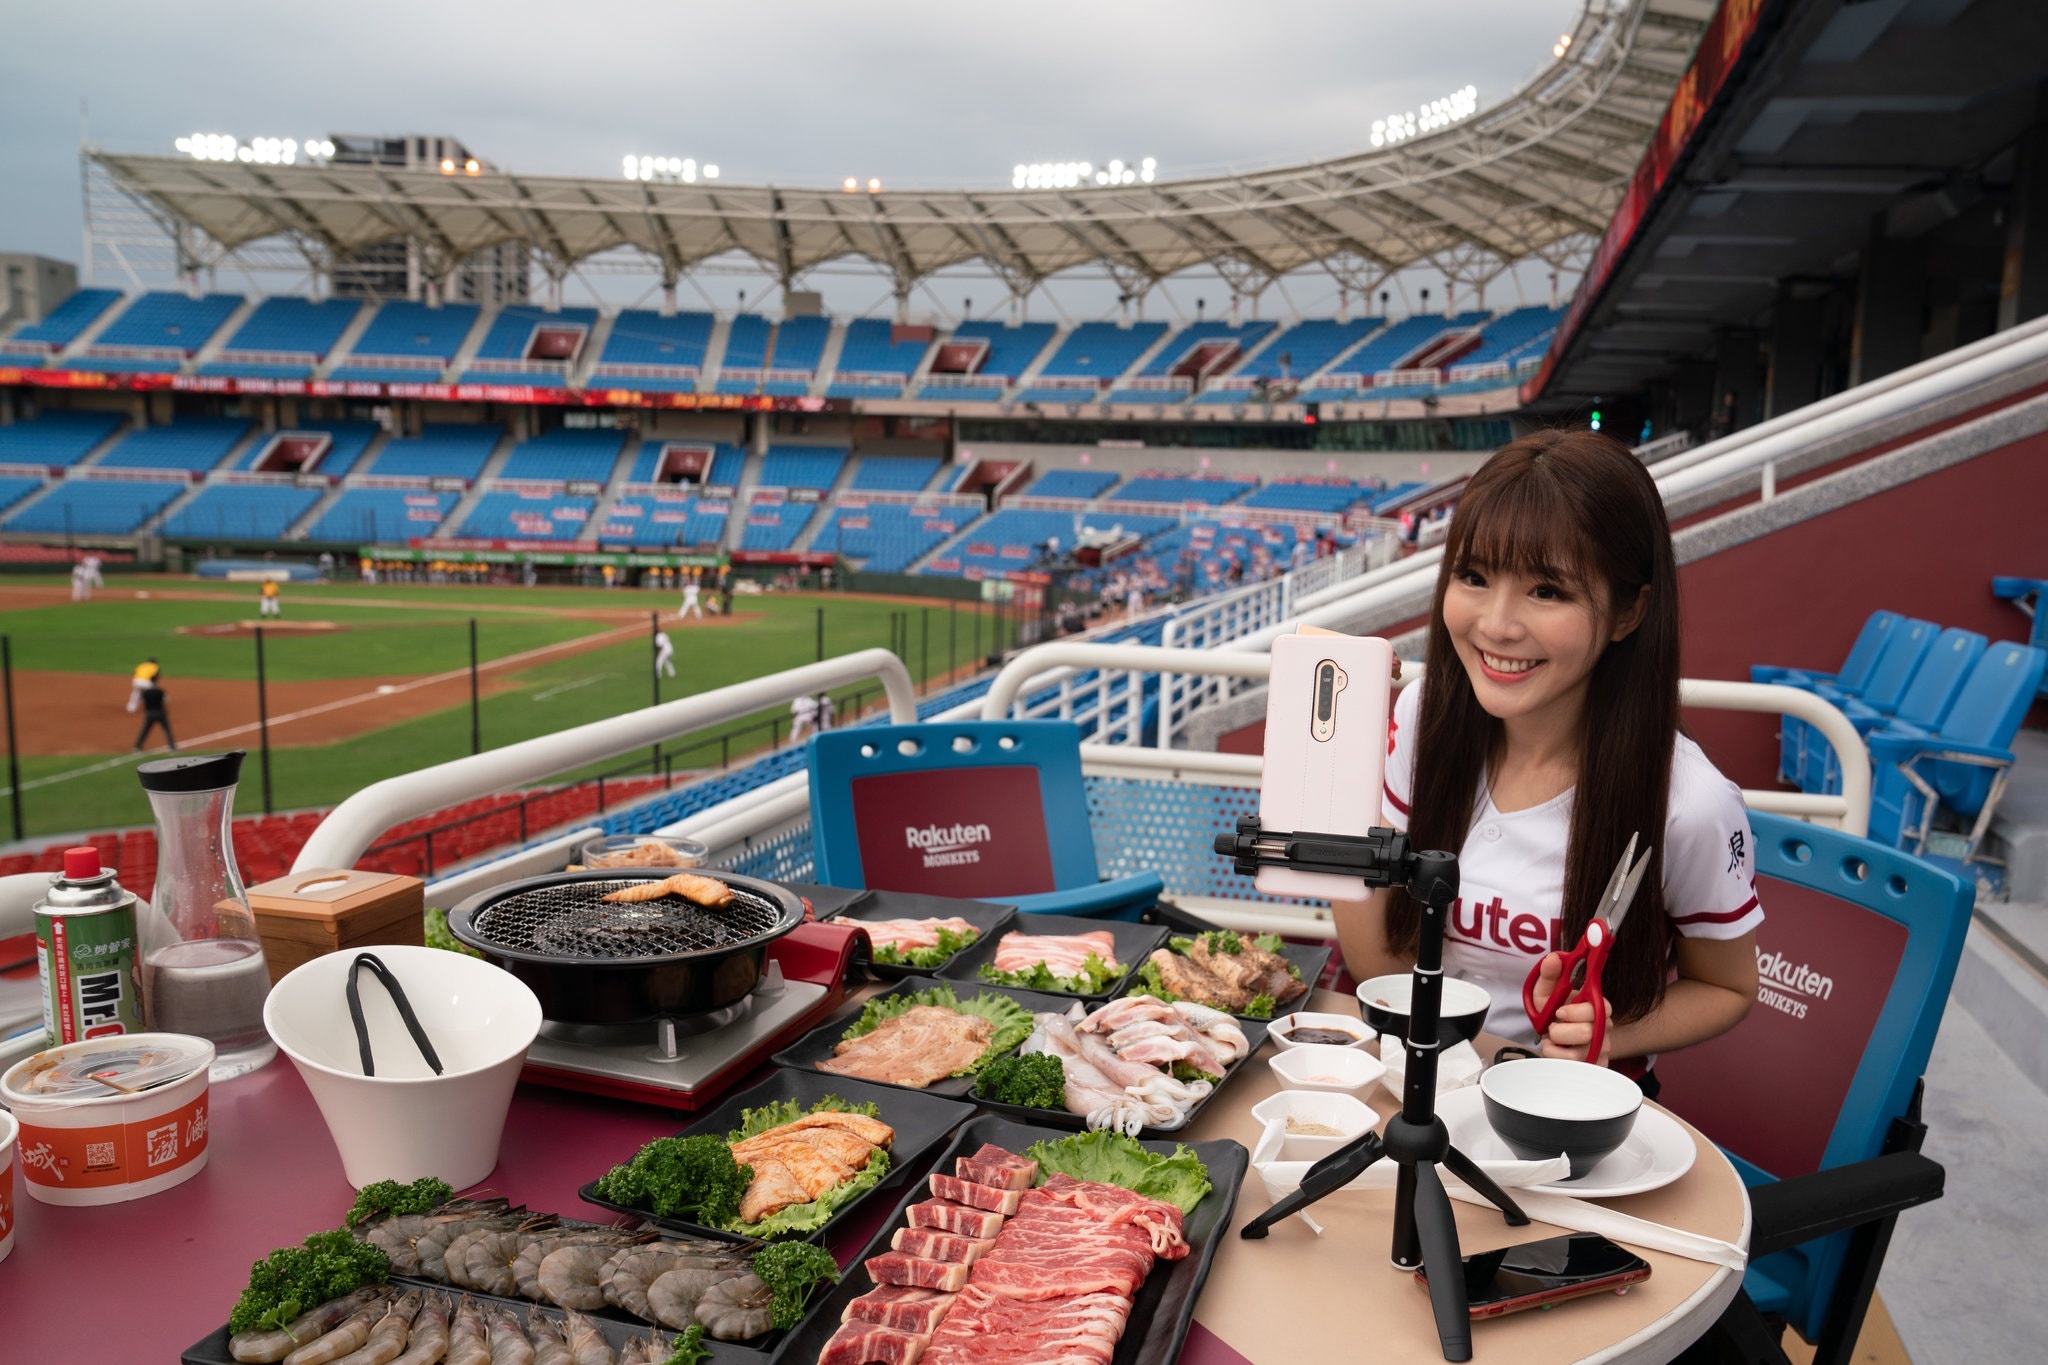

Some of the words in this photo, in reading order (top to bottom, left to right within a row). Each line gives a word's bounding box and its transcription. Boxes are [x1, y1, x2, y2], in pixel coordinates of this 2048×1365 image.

[906, 823, 991, 848] Rakuten
[923, 850, 980, 868] MONKEYS
[1445, 897, 1564, 955] ute
[1755, 945, 1834, 1000] akuten
[1757, 986, 1809, 1019] ONKEYS
[184, 1107, 209, 1149] 滷
[17, 1141, 66, 1182] 城
